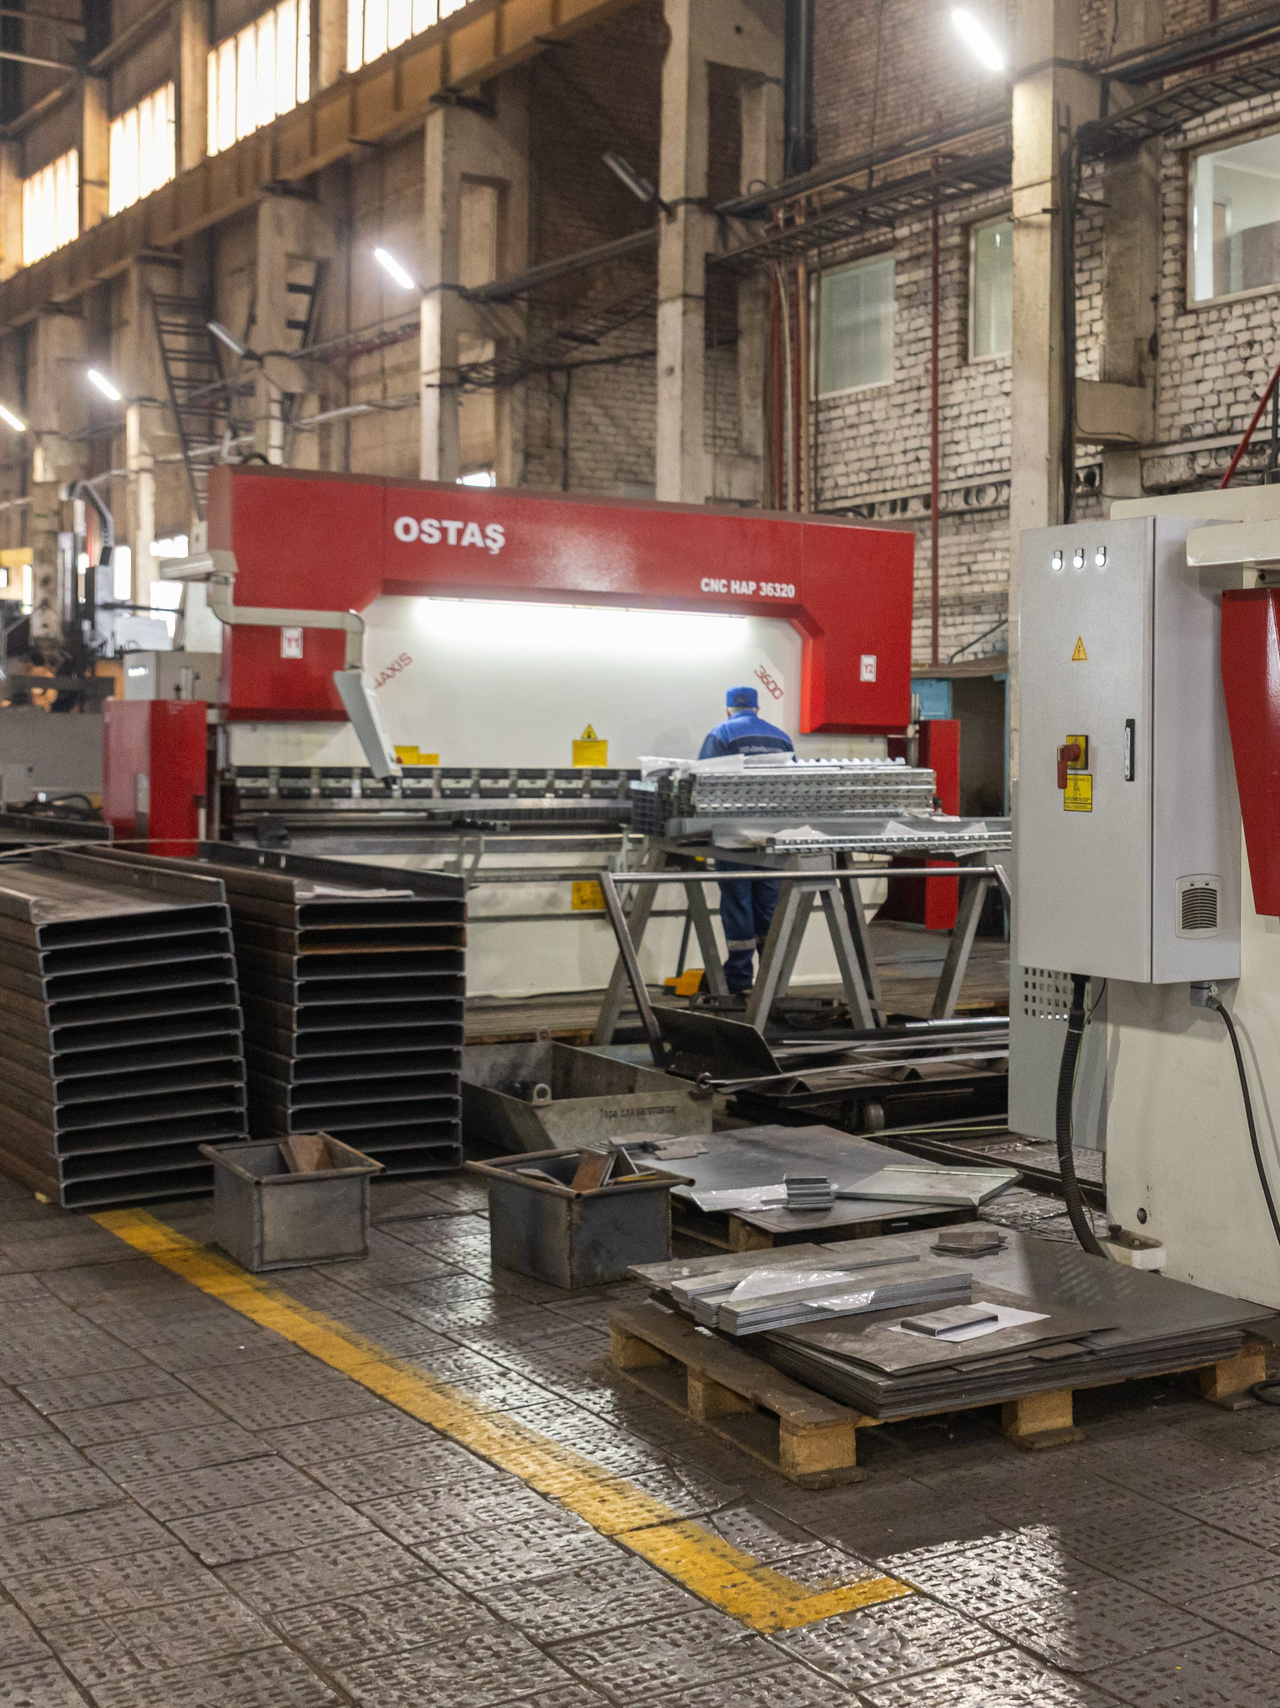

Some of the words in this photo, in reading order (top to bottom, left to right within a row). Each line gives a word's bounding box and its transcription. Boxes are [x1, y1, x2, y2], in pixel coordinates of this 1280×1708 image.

[394, 516, 506, 554] OSTAŞ
[700, 577, 728, 593] CNC
[730, 580, 757, 595] HAP
[759, 582, 795, 598] 36320
[754, 665, 784, 700] 3600
